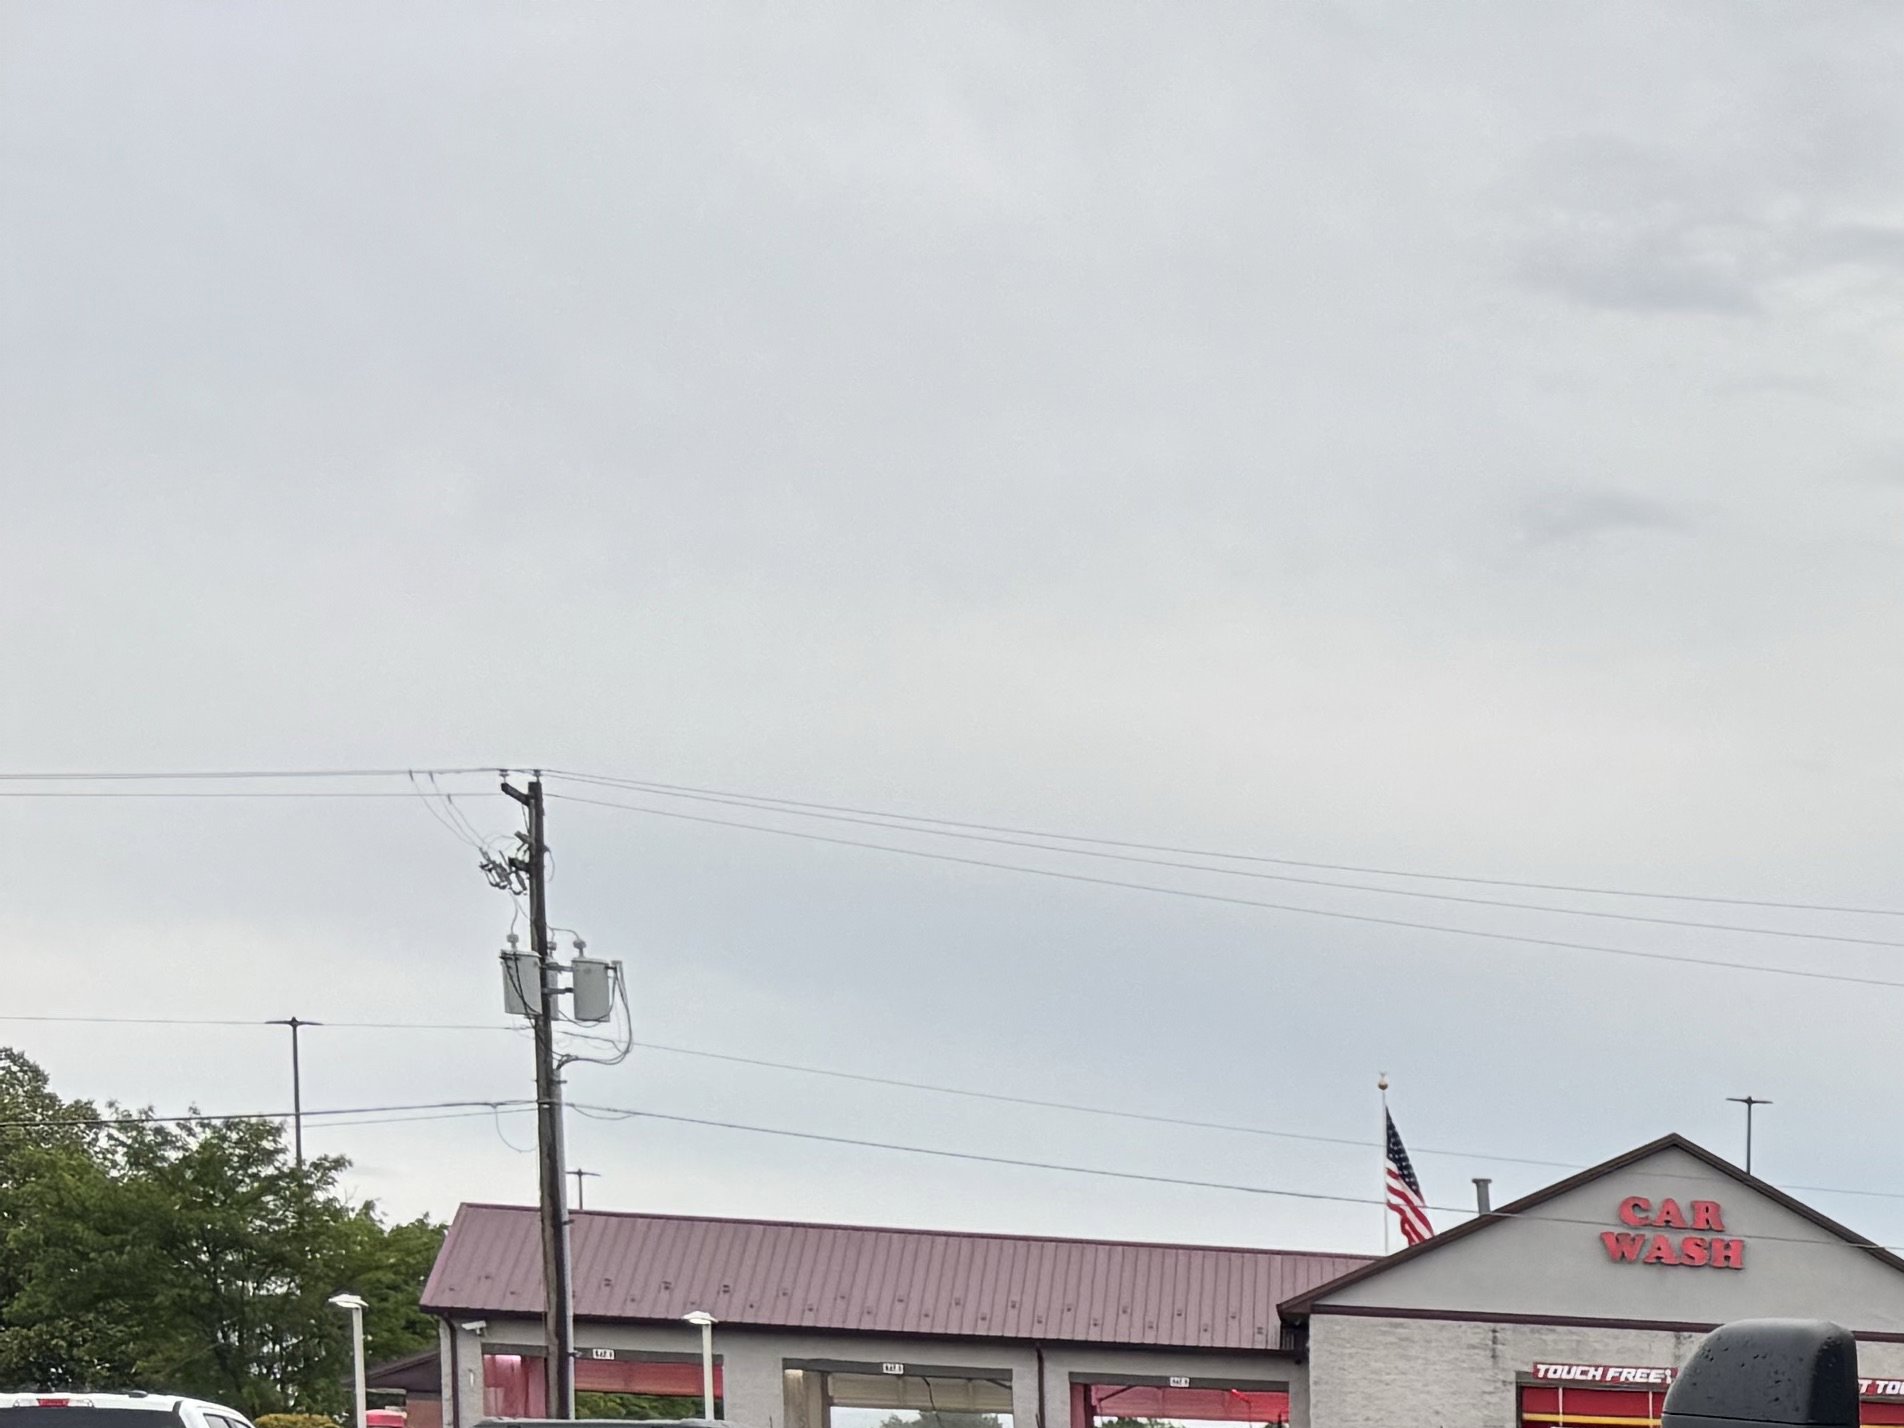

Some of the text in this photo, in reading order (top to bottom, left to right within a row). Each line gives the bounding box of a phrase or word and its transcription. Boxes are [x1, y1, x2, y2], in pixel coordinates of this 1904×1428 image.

[1619, 1196, 1725, 1232] CAR
[1600, 1231, 1745, 1270] WASH
[1536, 1364, 1666, 1383] TOUCH FREE
